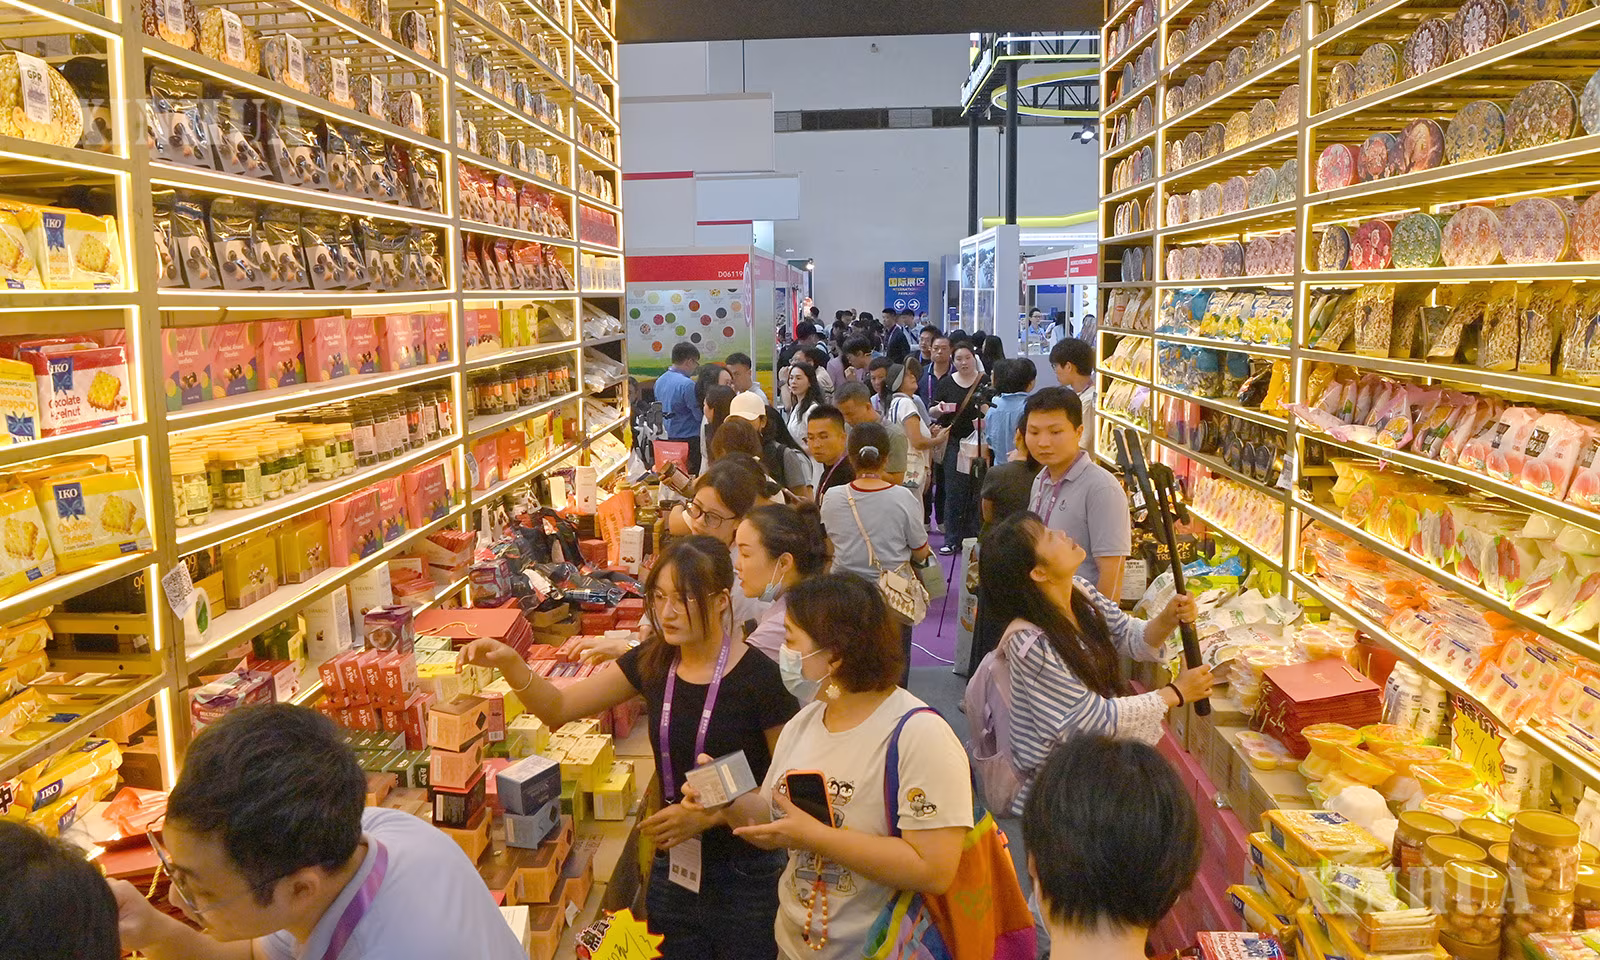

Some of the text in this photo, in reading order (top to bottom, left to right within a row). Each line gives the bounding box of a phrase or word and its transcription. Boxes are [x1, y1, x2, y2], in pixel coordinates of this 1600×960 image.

[27, 69, 42, 82] GPR
[45, 218, 61, 229] IKO
[50, 363, 69, 374] IKO
[48, 395, 81, 409] Cocolate
[58, 488, 78, 499] IKO
[1157, 541, 1191, 554] BLCK
[1156, 551, 1191, 560] TRULES
[41, 784, 59, 799] IKO
